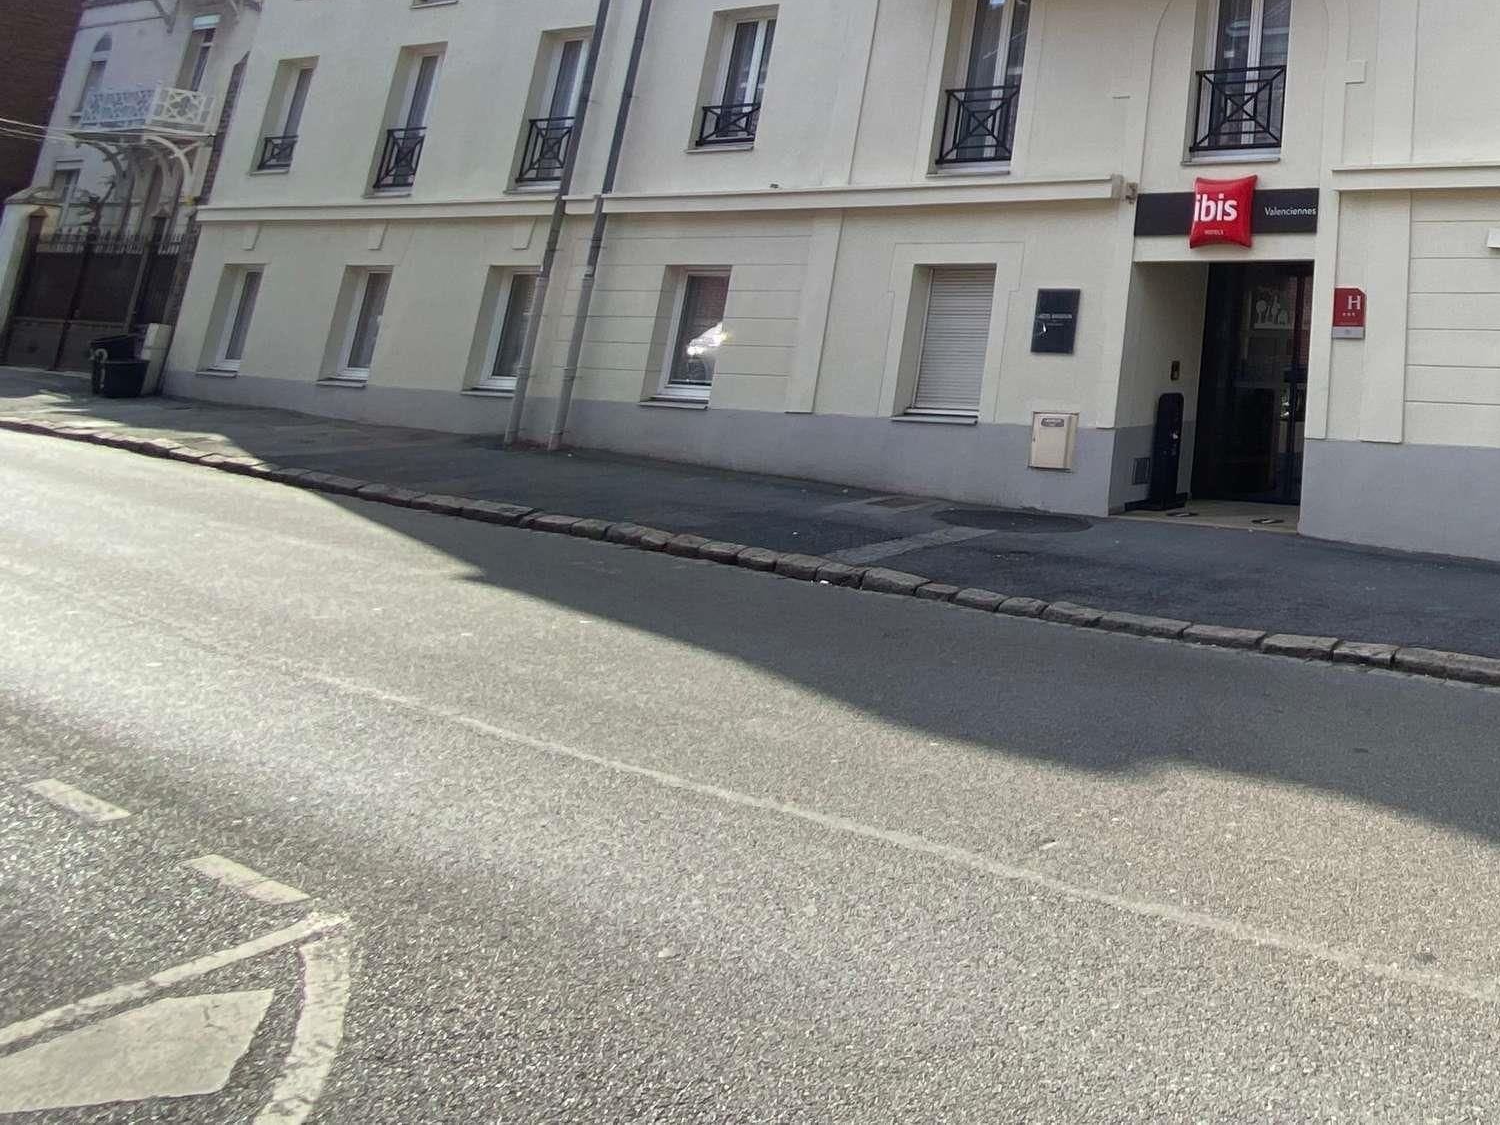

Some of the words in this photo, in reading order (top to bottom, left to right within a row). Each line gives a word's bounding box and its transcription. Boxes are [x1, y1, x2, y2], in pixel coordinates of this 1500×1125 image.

[1194, 193, 1238, 222] ibis
[1264, 206, 1317, 216] Valenciennes
[1347, 295, 1361, 310] H
